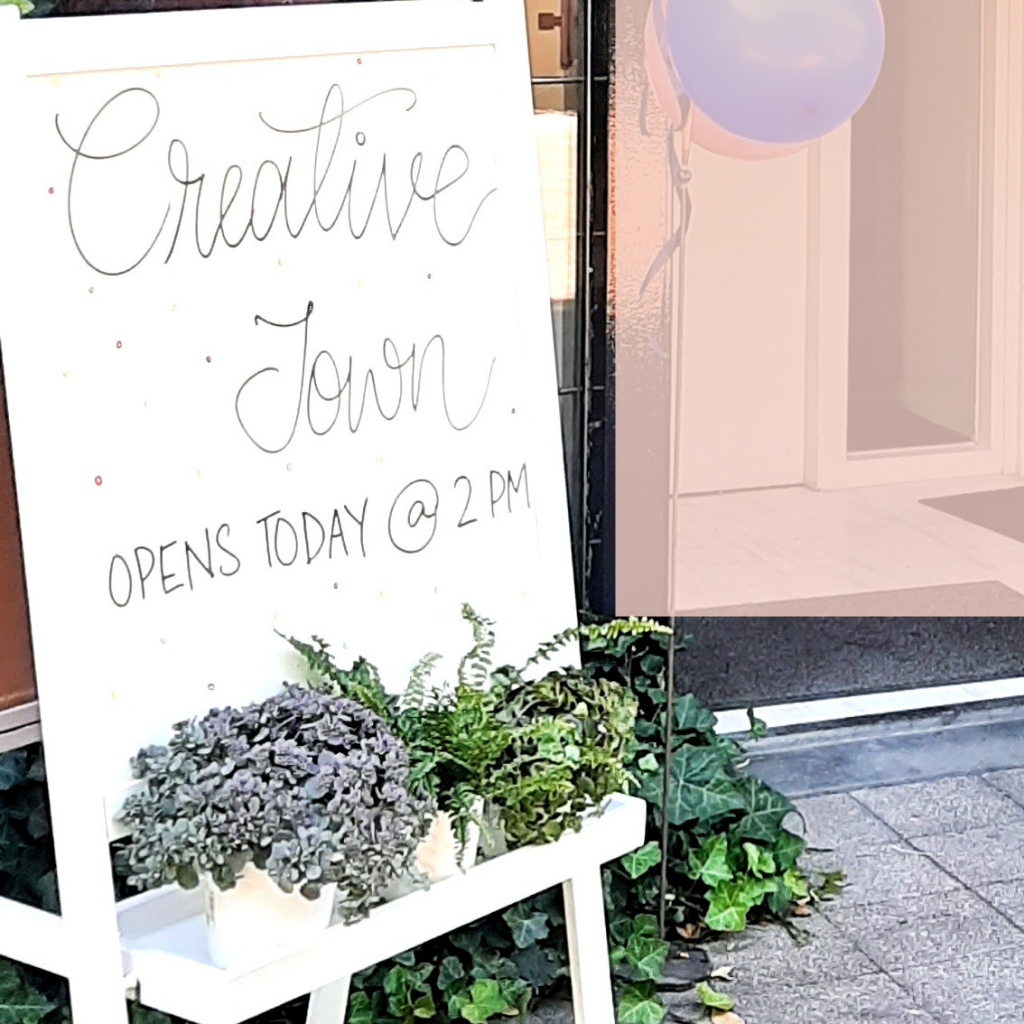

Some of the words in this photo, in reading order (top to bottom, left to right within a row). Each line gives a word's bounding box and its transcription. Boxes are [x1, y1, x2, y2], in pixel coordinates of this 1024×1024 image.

[55, 83, 498, 276] Creative
[235, 299, 497, 453] Town
[108, 523, 240, 607] OPENS
[256, 497, 369, 567] TODAY
[388, 478, 439, 554] @
